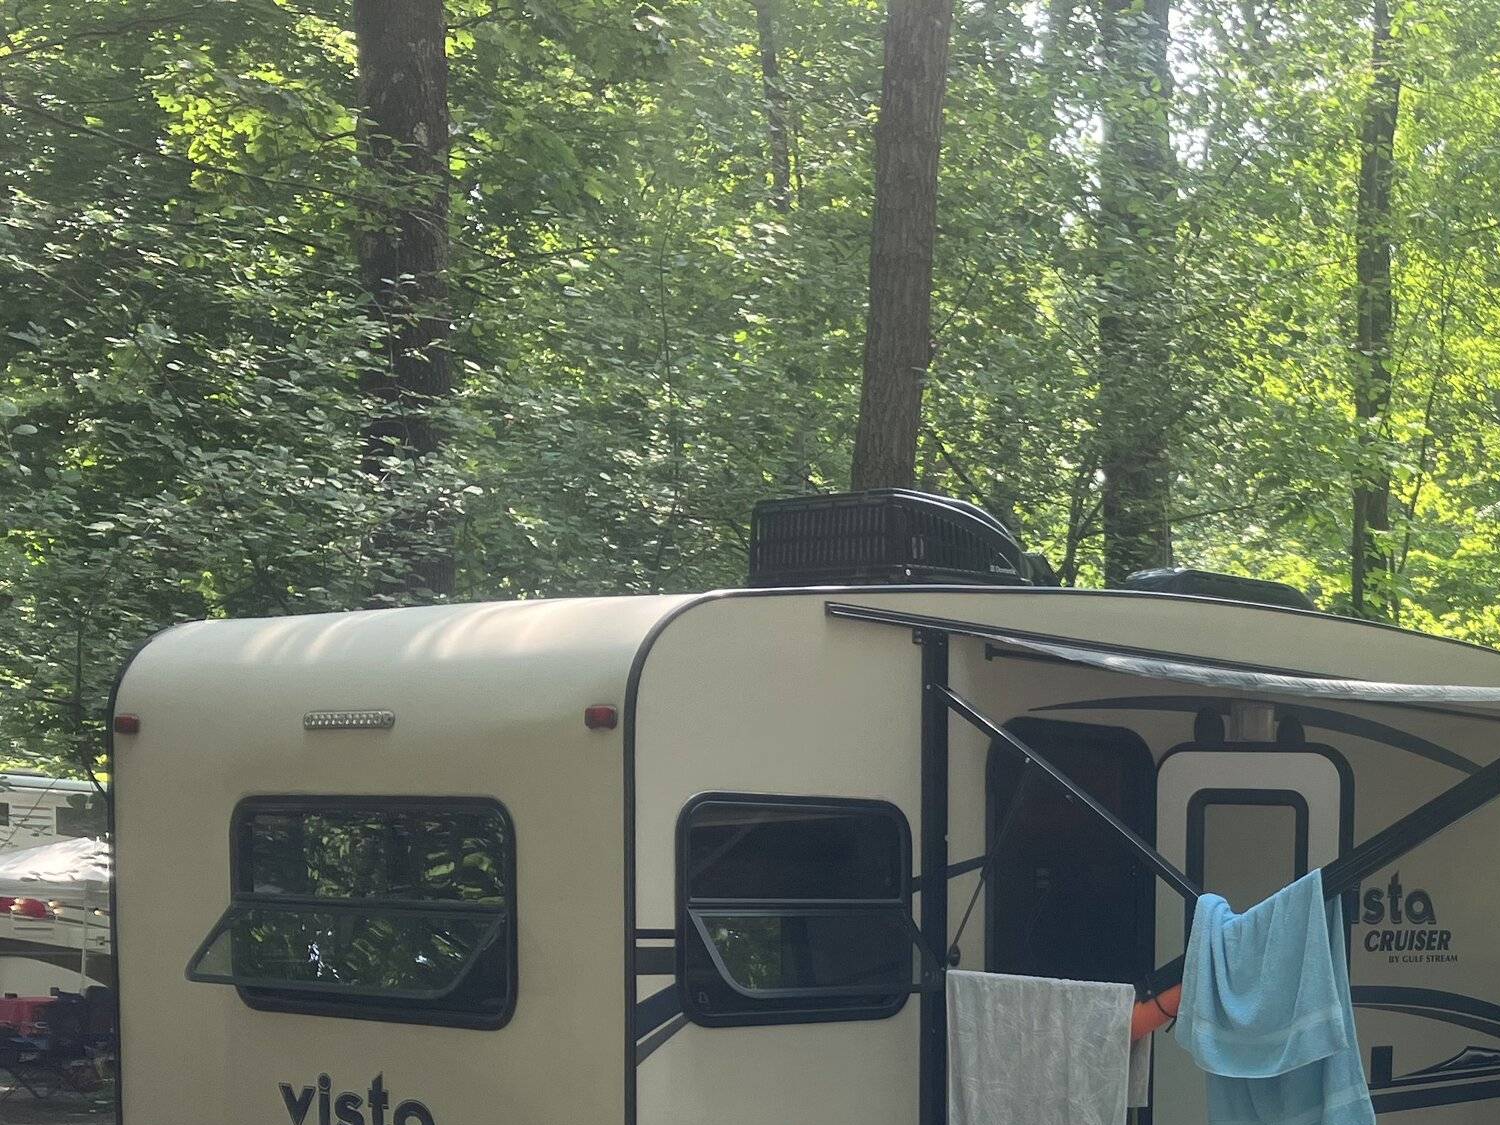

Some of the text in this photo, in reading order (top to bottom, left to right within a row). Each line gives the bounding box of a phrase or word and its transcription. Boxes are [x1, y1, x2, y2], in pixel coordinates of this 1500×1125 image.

[1350, 869, 1437, 925] ista
[1364, 929, 1452, 952] CRUISER
[1388, 954, 1459, 963] BY GULF STREAM
